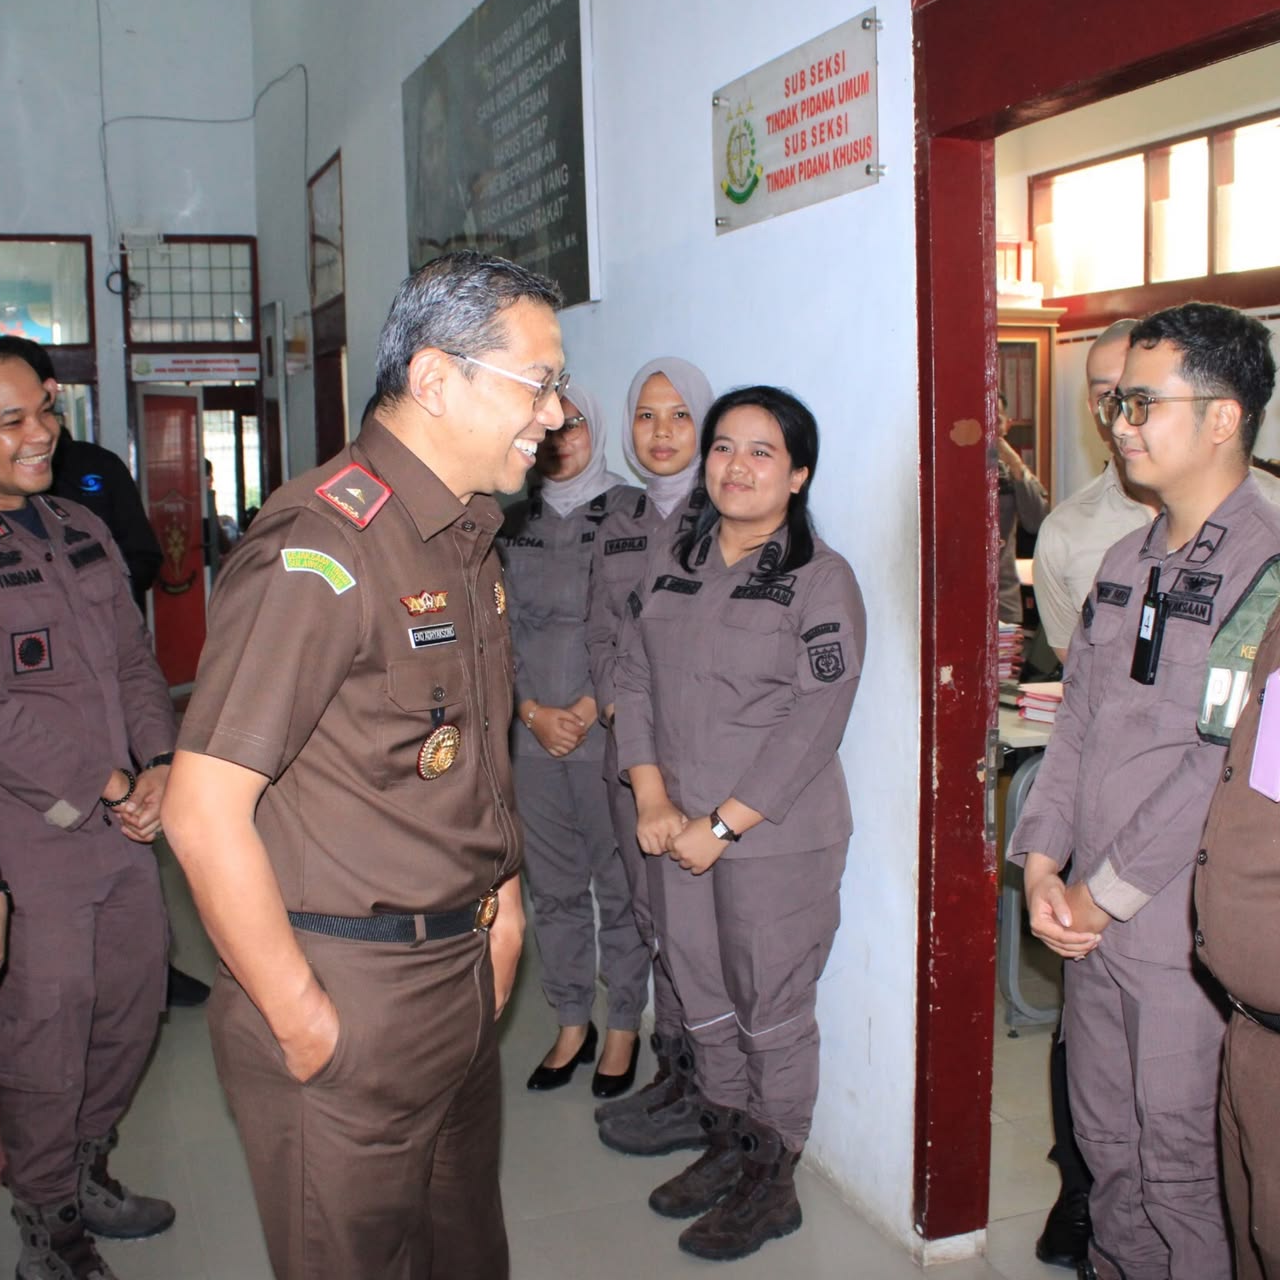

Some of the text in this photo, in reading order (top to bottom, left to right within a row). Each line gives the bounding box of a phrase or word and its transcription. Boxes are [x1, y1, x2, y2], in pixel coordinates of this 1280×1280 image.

[784, 50, 846, 98] SUB SEKSI
[766, 71, 870, 136] TINDAK PIDANA UMUM
[784, 112, 849, 158] SUB SEKSI
[543, 163, 569, 194] YANG
[766, 135, 873, 194] TINDAK PIDANA KHUSUS
[1240, 644, 1257, 660] KE
[1201, 667, 1252, 729] PI
